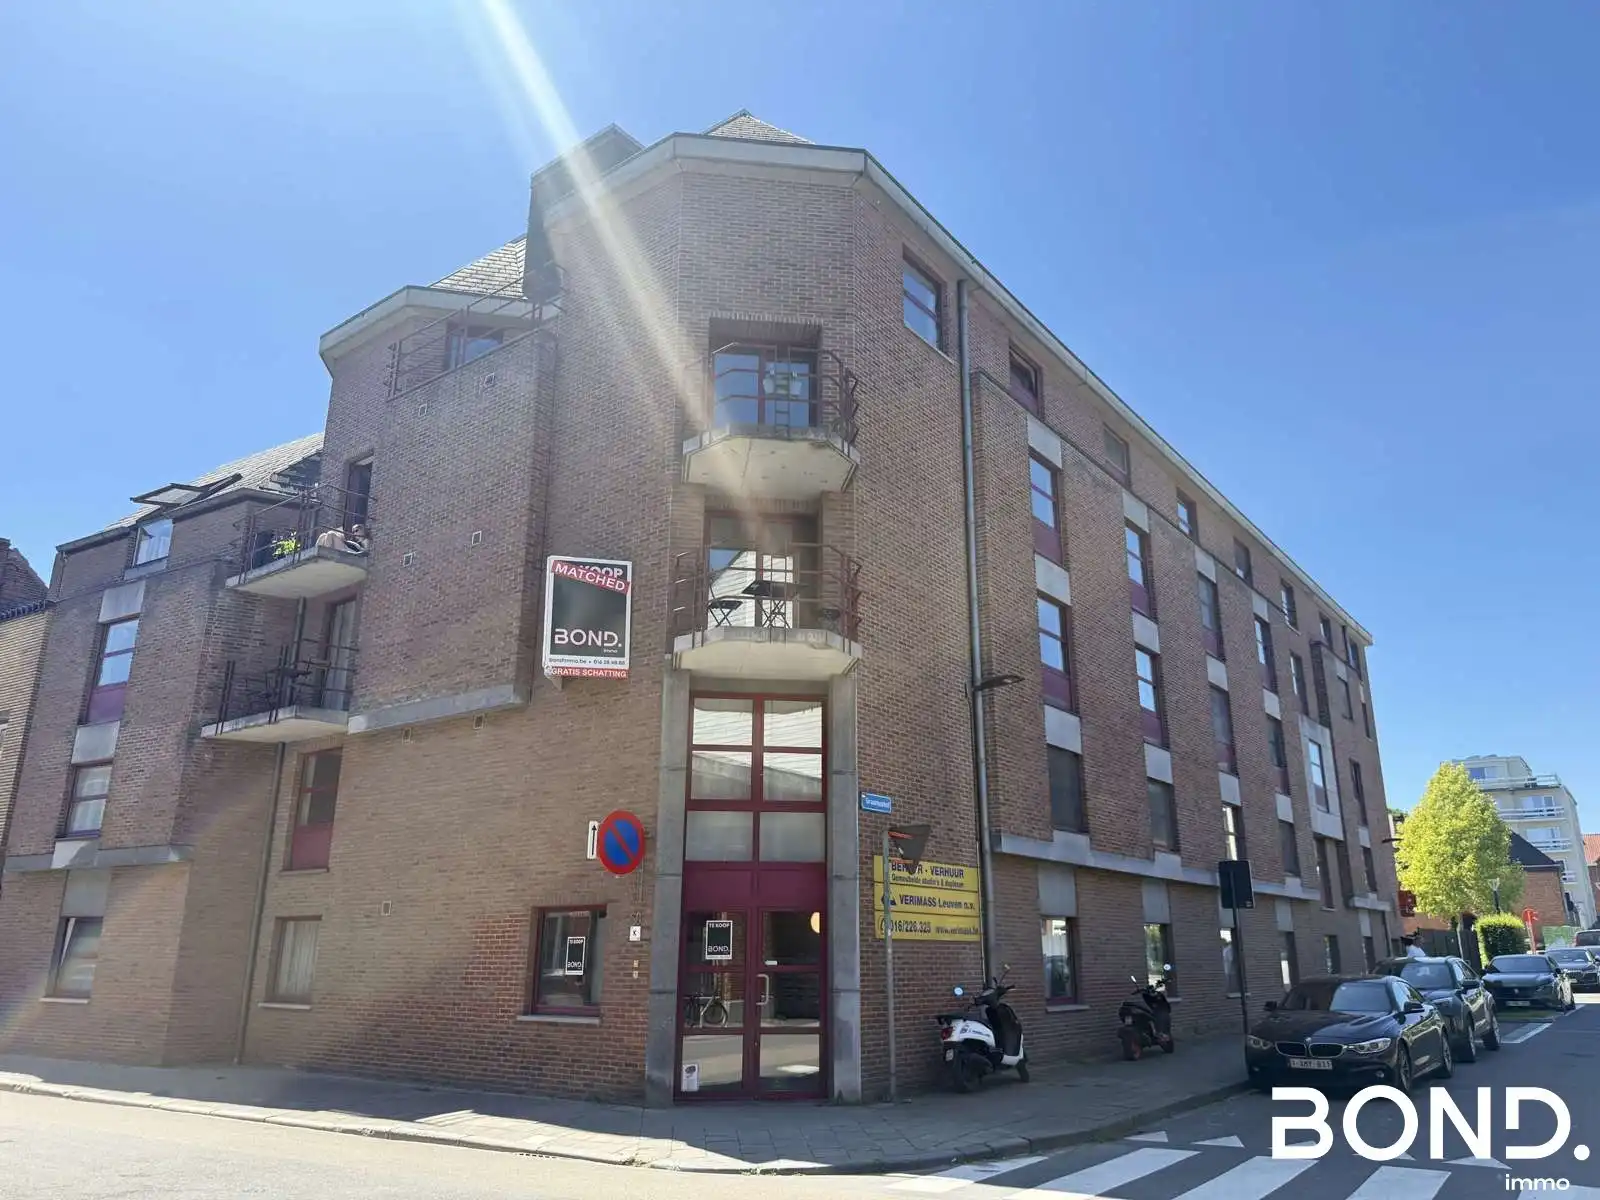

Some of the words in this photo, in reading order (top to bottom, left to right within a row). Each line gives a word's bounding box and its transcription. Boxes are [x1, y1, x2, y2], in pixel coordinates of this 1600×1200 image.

[554, 563, 625, 591] MATCHED
[554, 628, 622, 648] BOND.
[552, 667, 580, 676] GRATIS
[582, 669, 627, 678] SCHATTING
[930, 866, 964, 879] VERHUUR
[899, 894, 936, 907] VERIMASS
[938, 898, 962, 909] Leuven
